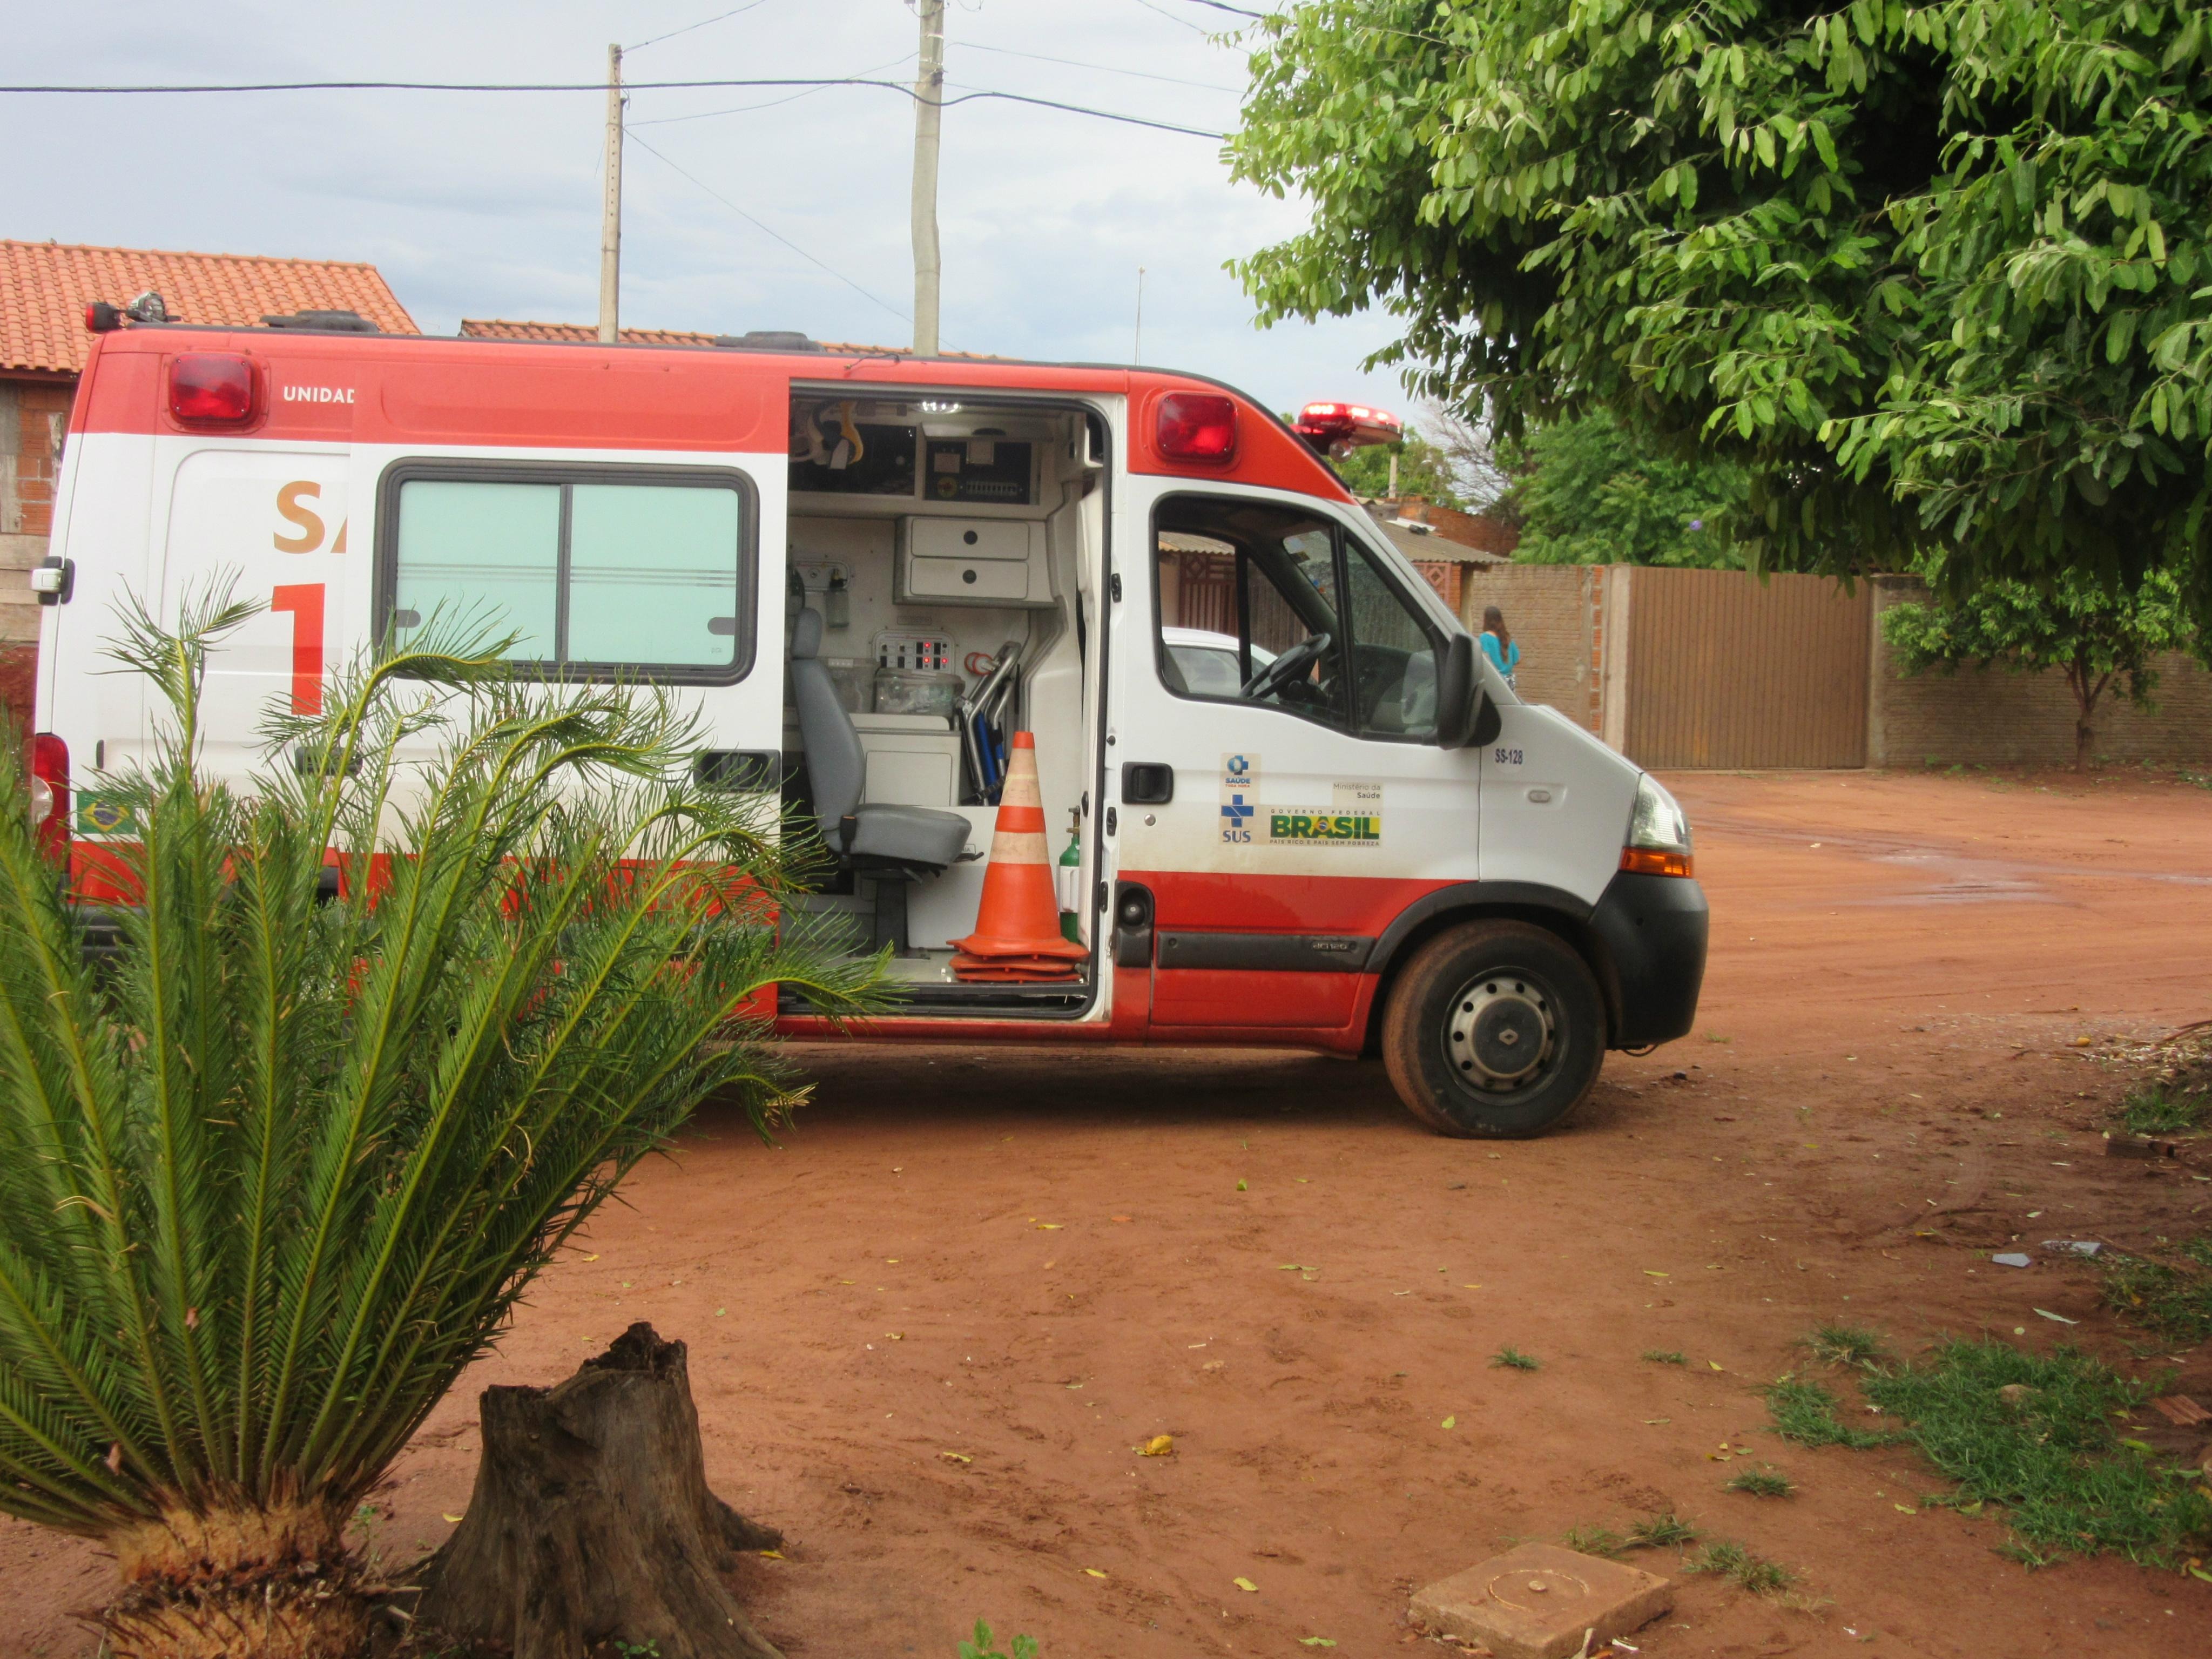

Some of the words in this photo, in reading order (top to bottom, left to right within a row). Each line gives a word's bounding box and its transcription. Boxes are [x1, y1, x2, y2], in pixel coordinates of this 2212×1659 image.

[1495, 748, 1523, 765] SS-128
[1271, 815, 1380, 839] BRASIL
[1222, 830, 1251, 843] SUS
